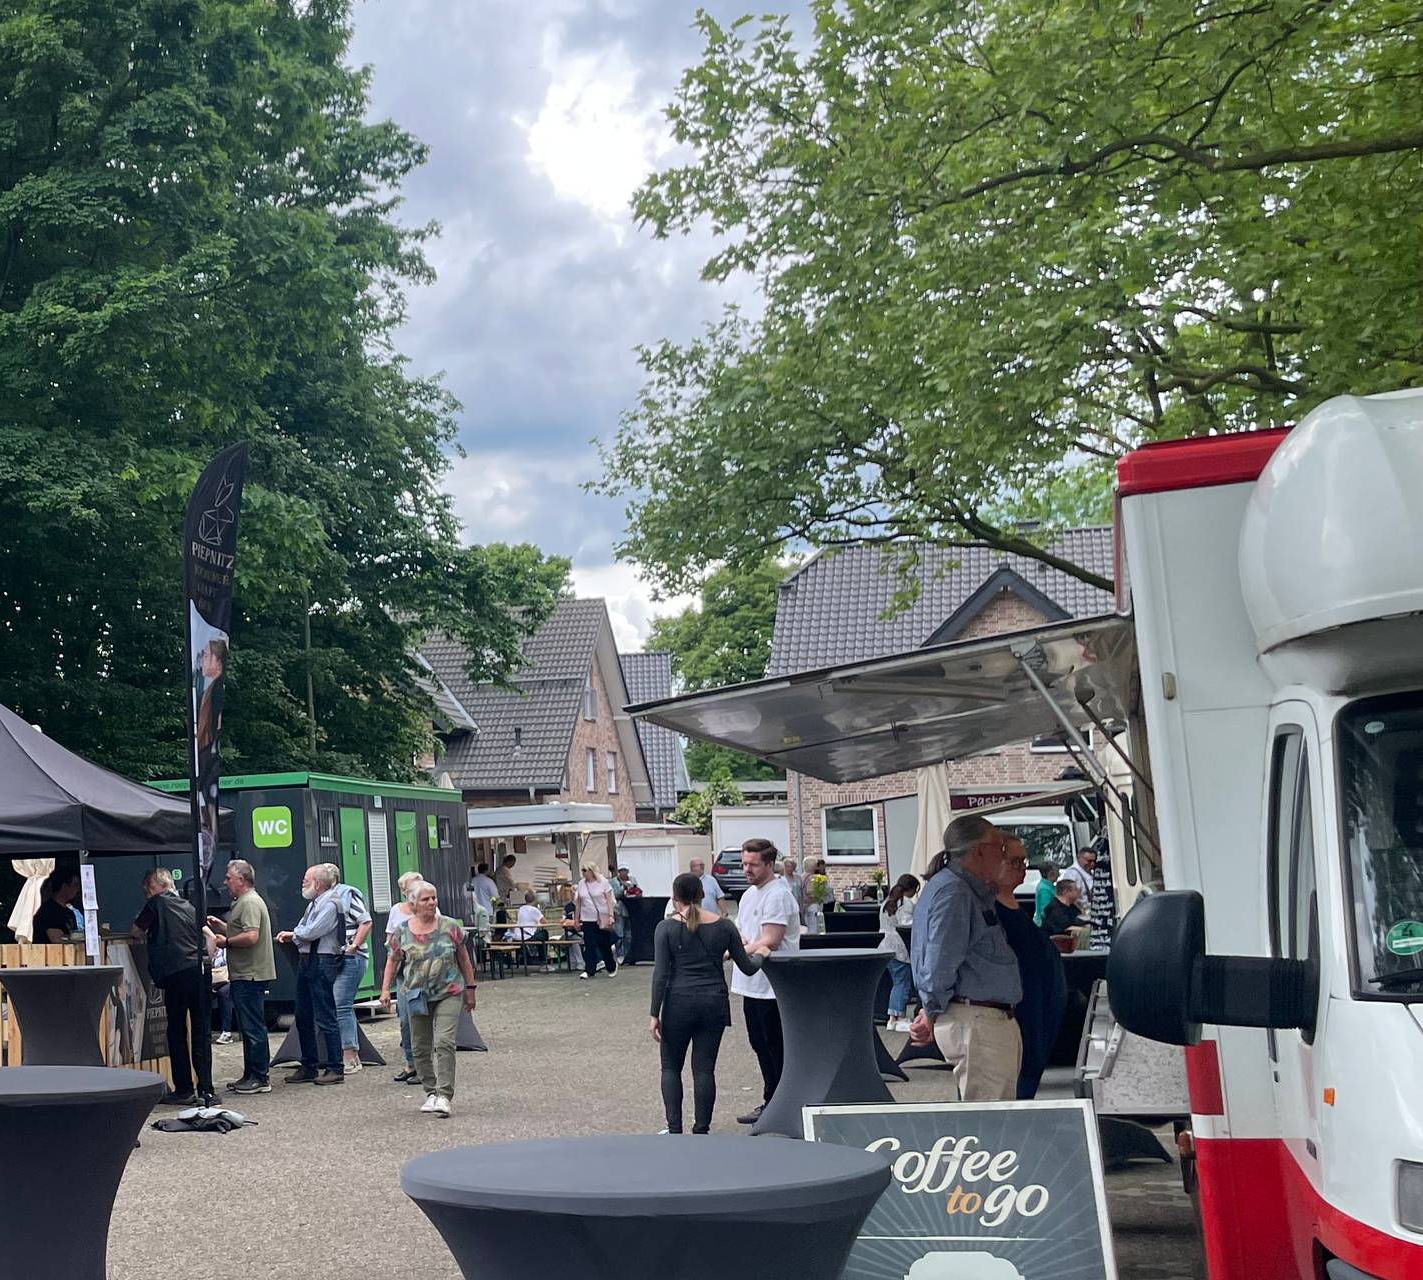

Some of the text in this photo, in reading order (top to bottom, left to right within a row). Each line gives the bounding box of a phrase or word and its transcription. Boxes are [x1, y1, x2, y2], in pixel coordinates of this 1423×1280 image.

[191, 540, 235, 569] PIEPNITZ
[967, 794, 1006, 808] Pasta
[257, 819, 288, 835] WC
[946, 1184, 1049, 1227] to go
